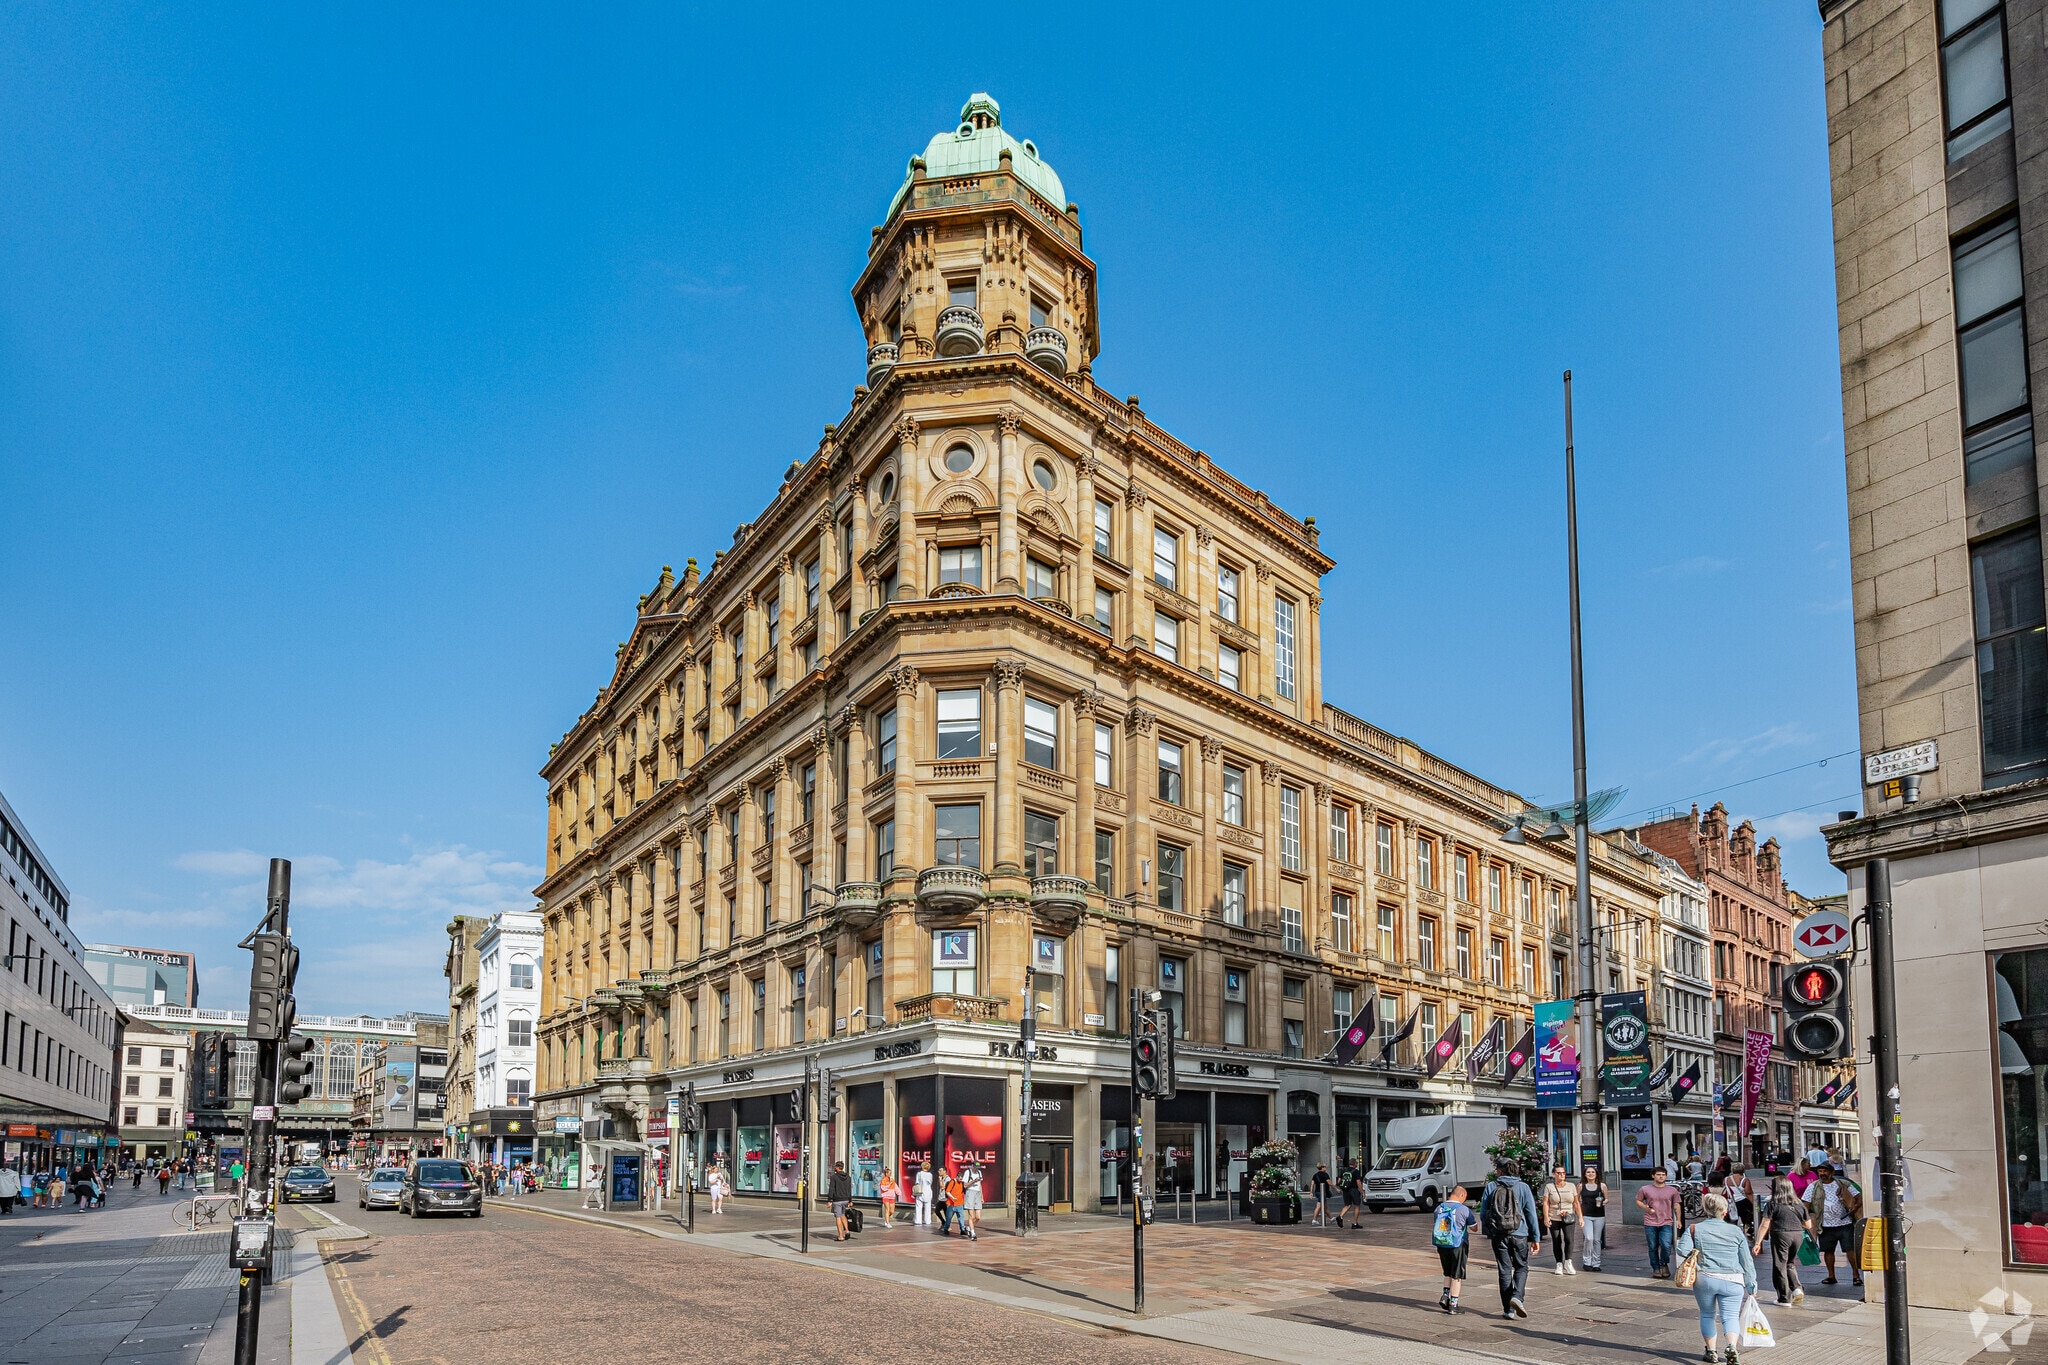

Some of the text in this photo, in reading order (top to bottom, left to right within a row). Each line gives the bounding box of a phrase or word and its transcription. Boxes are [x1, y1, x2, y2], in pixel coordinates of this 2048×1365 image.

[1869, 745, 1932, 767] ARGYLE
[1871, 756, 1931, 776] STREET
[1898, 768, 1918, 776] CENTRE
[1542, 1019, 1564, 1028] Piping
[988, 1041, 1058, 1062] FRAERS
[1471, 1038, 1490, 1061] CREED
[1749, 1034, 1764, 1067] MAKE
[1750, 1036, 1772, 1093] GLASGOW
[1030, 1100, 1061, 1111] ASERS
[745, 1151, 762, 1160] SALE
[780, 1149, 798, 1159] SALE
[858, 1149, 879, 1158] SALE
[903, 1151, 931, 1162] SALE
[951, 1151, 996, 1162] SALE
[1103, 1150, 1127, 1158] SALE
[1170, 1150, 1192, 1158] SALE
